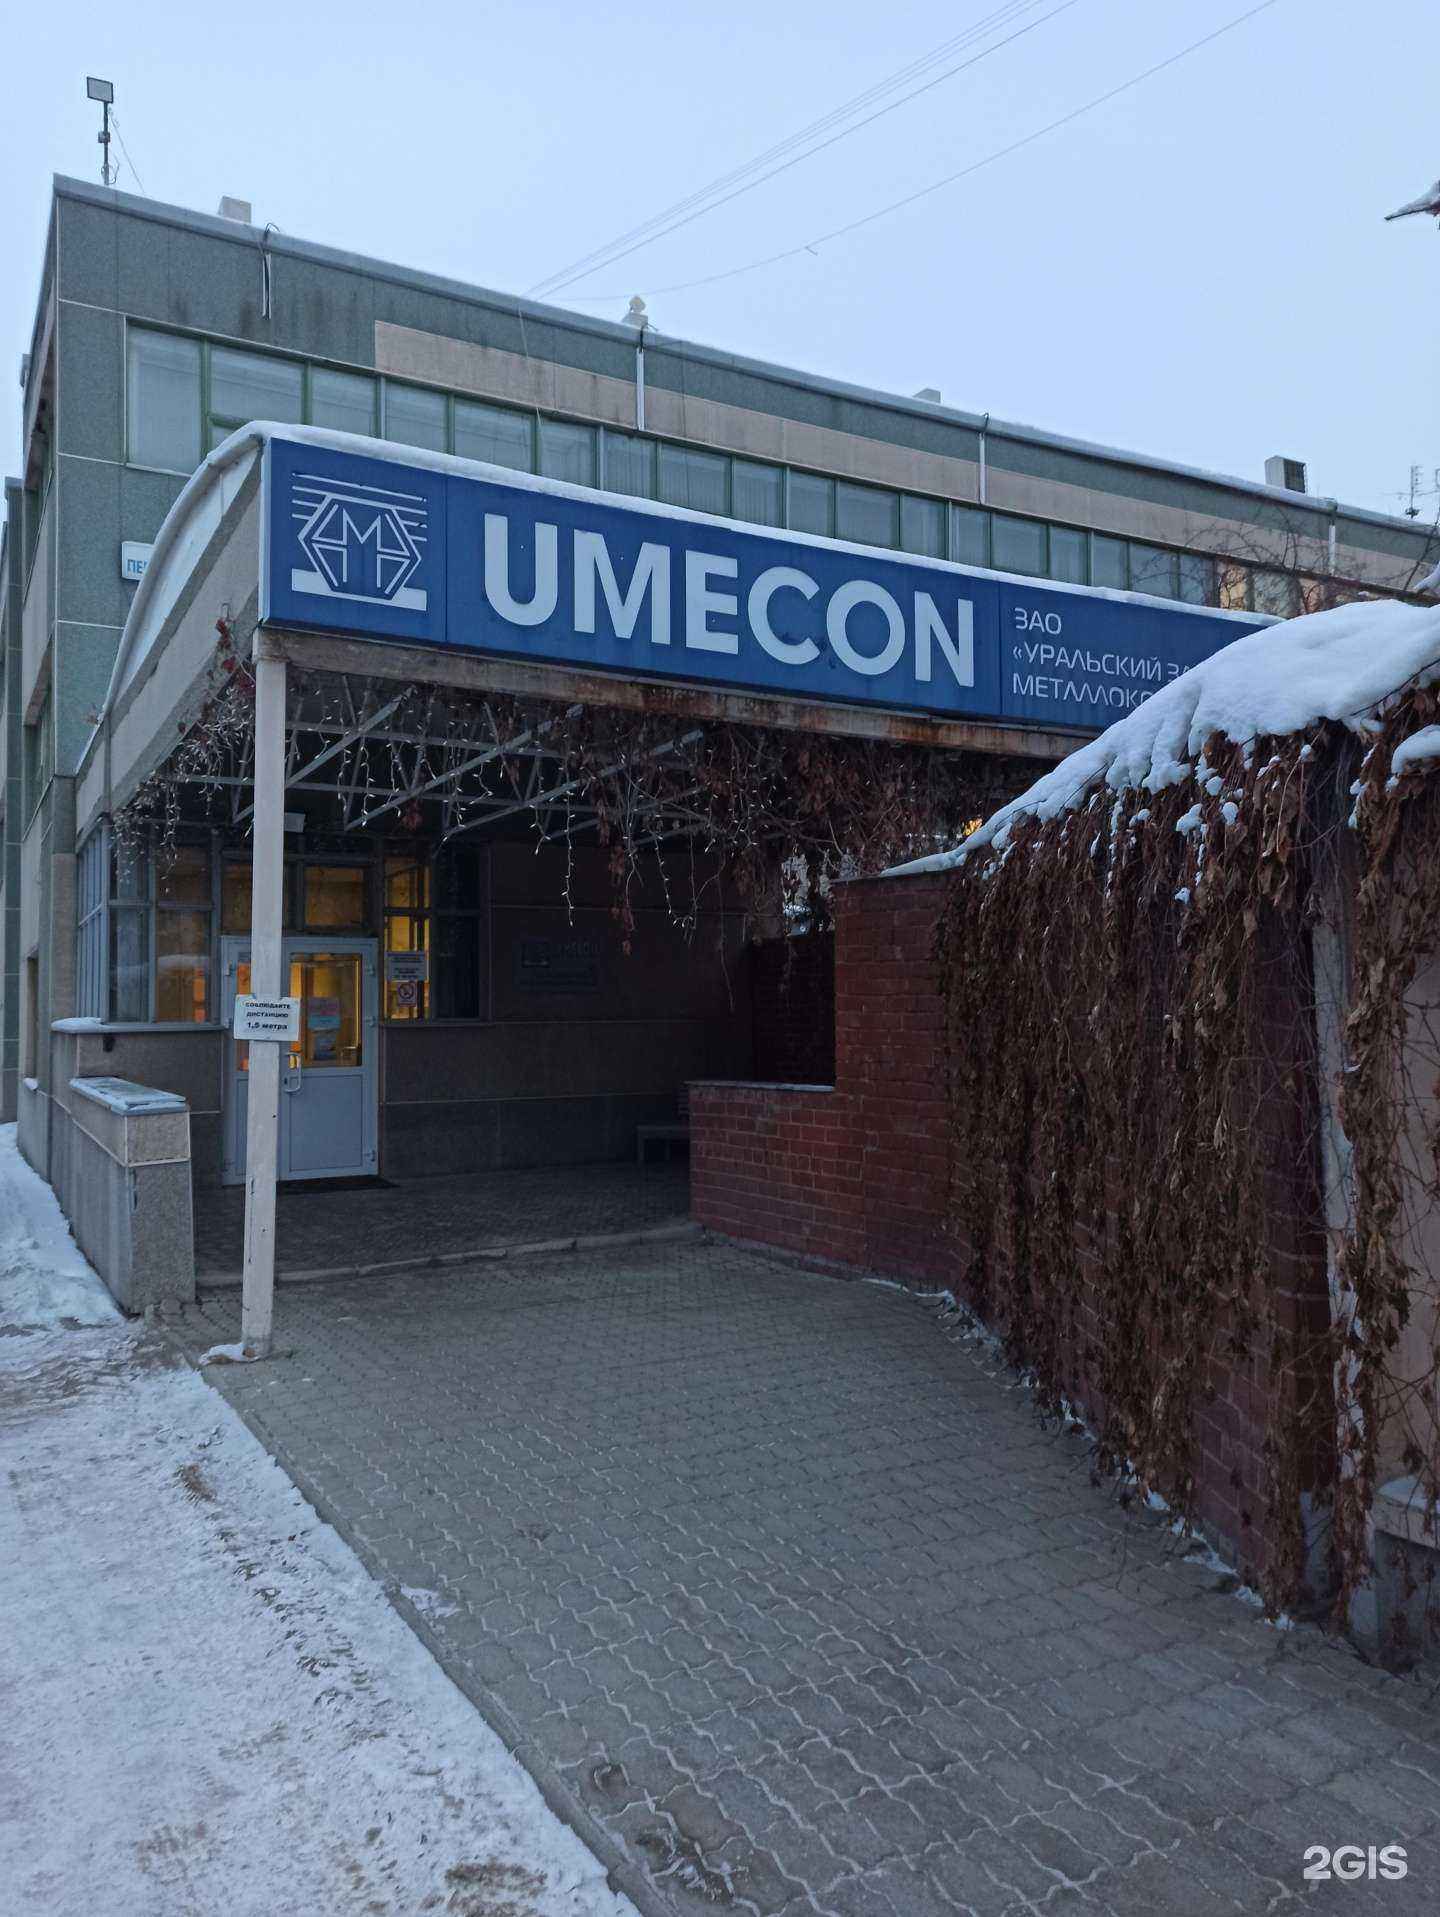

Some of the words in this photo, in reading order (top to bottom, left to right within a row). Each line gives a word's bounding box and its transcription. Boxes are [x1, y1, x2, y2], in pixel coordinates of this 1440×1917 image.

[483, 512, 975, 688] UMECON
[1014, 607, 1062, 635] ЗАО
[1012, 642, 1162, 681] «УРАЛЬСКИЙ
